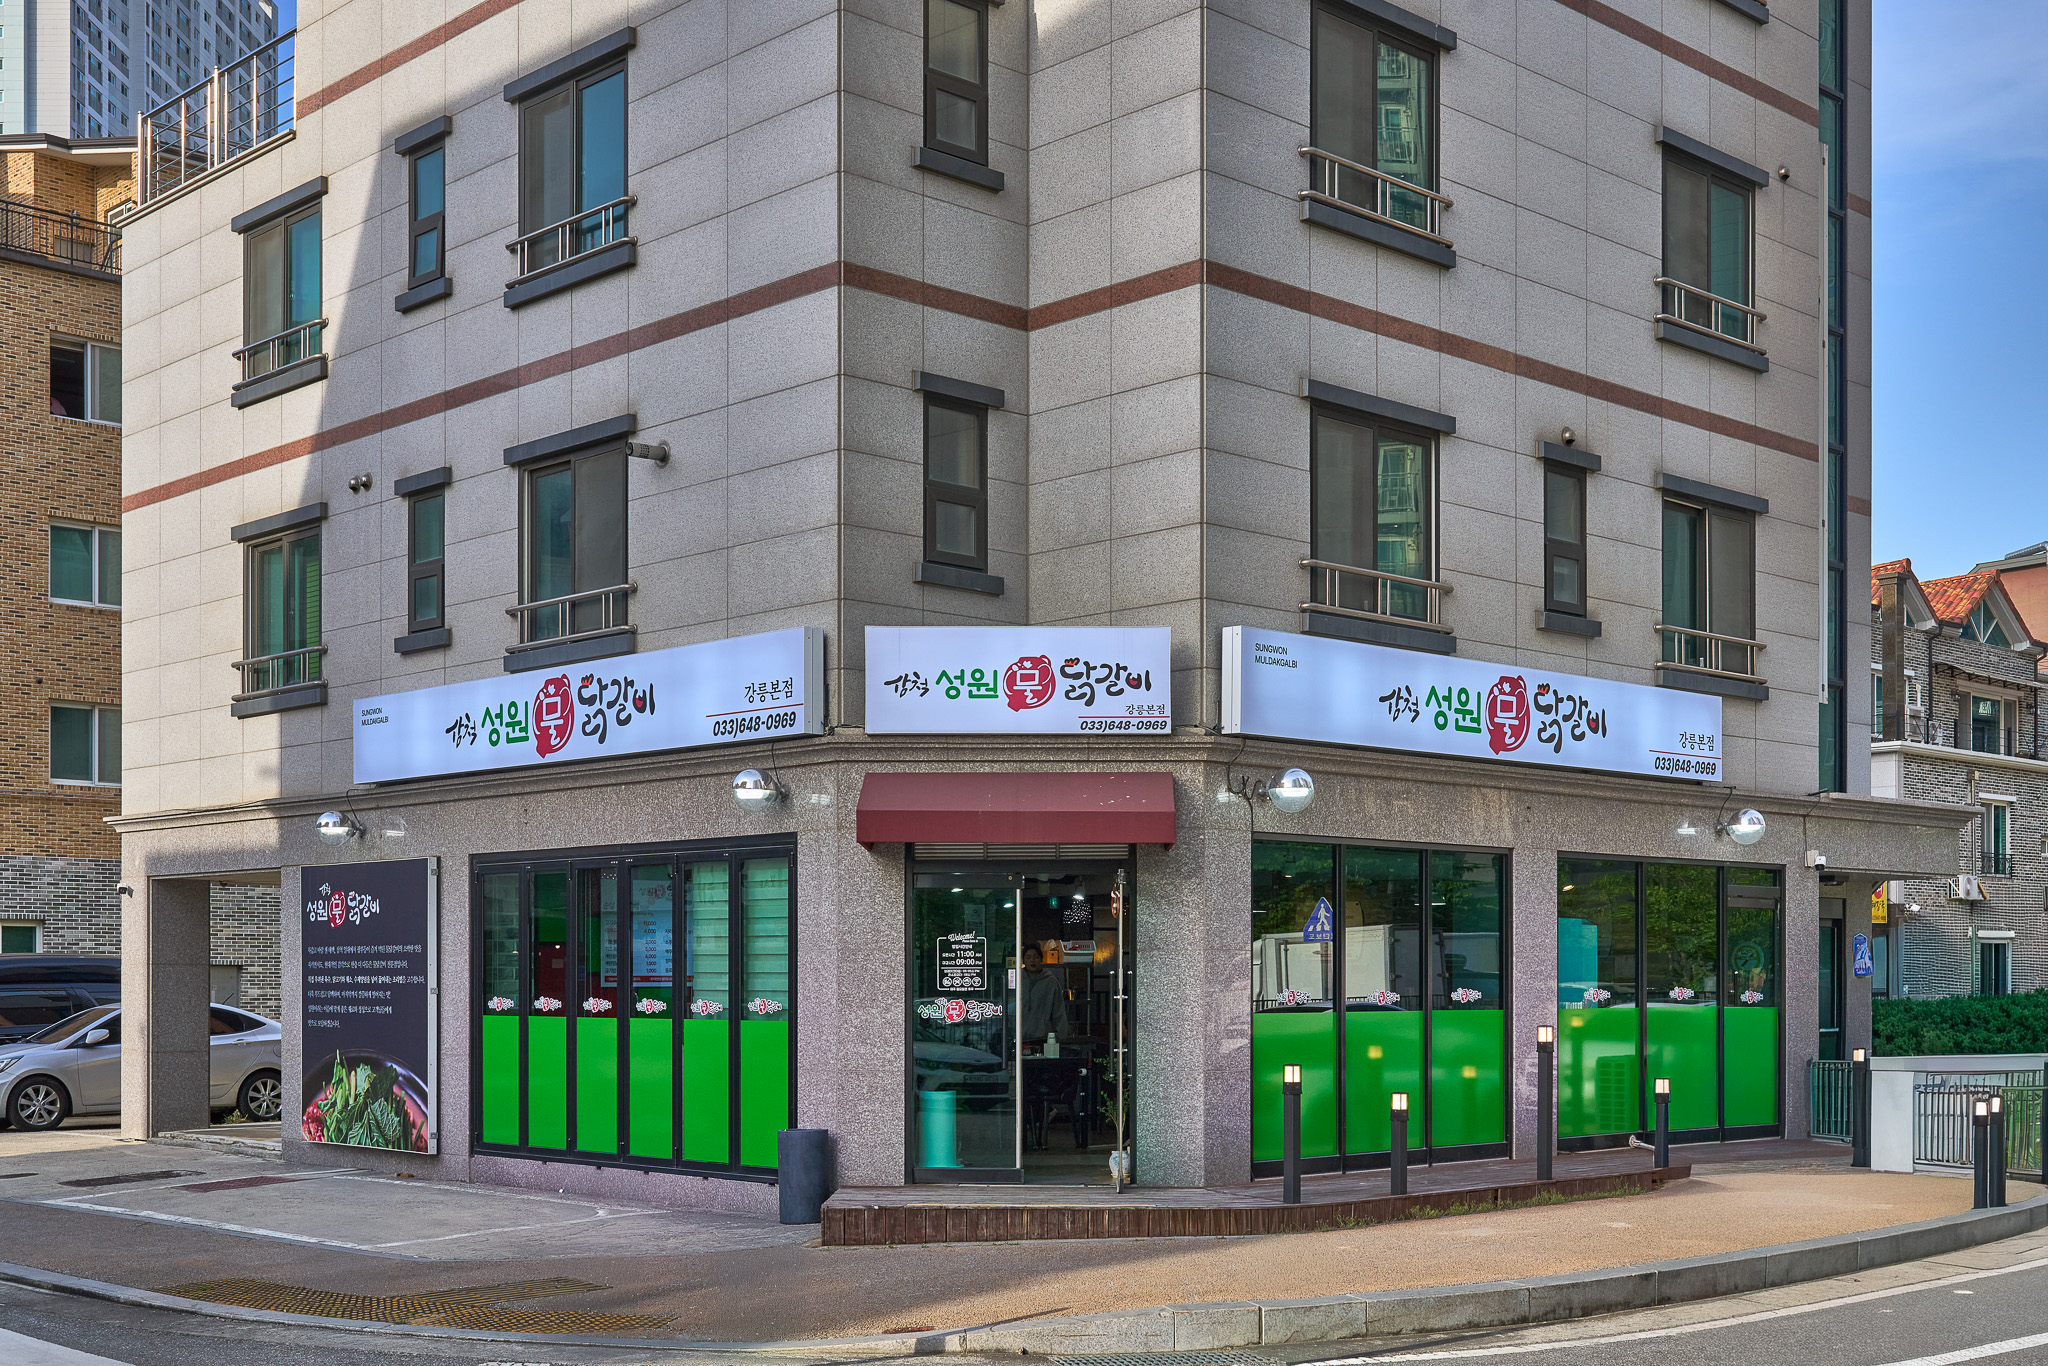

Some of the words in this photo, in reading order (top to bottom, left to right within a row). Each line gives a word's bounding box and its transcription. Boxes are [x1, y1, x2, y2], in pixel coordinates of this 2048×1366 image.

[1254, 642, 1288, 655] SUNGWON
[1254, 655, 1298, 669] MULDAKGALBI
[744, 677, 793, 703] 강릉본점
[883, 671, 930, 698] 삼척
[935, 668, 999, 700] 성원
[361, 707, 383, 717] SUNGWON
[1125, 703, 1166, 715] 강릉본점
[1378, 684, 1421, 723] 삼척
[1425, 685, 1482, 734] 성원
[445, 712, 478, 749] 삼척
[481, 700, 530, 747] 성원
[713, 711, 797, 738] 033)648-0969
[1080, 720, 1168, 733] 033)648-0969
[1679, 731, 1715, 752] 강릉본점
[1654, 756, 1717, 776] 033)648-0969
[306, 899, 329, 922] 성원
[956, 950, 975, 958] 11:00
[956, 958, 975, 966] 09:00
[918, 1004, 945, 1019] 성원
